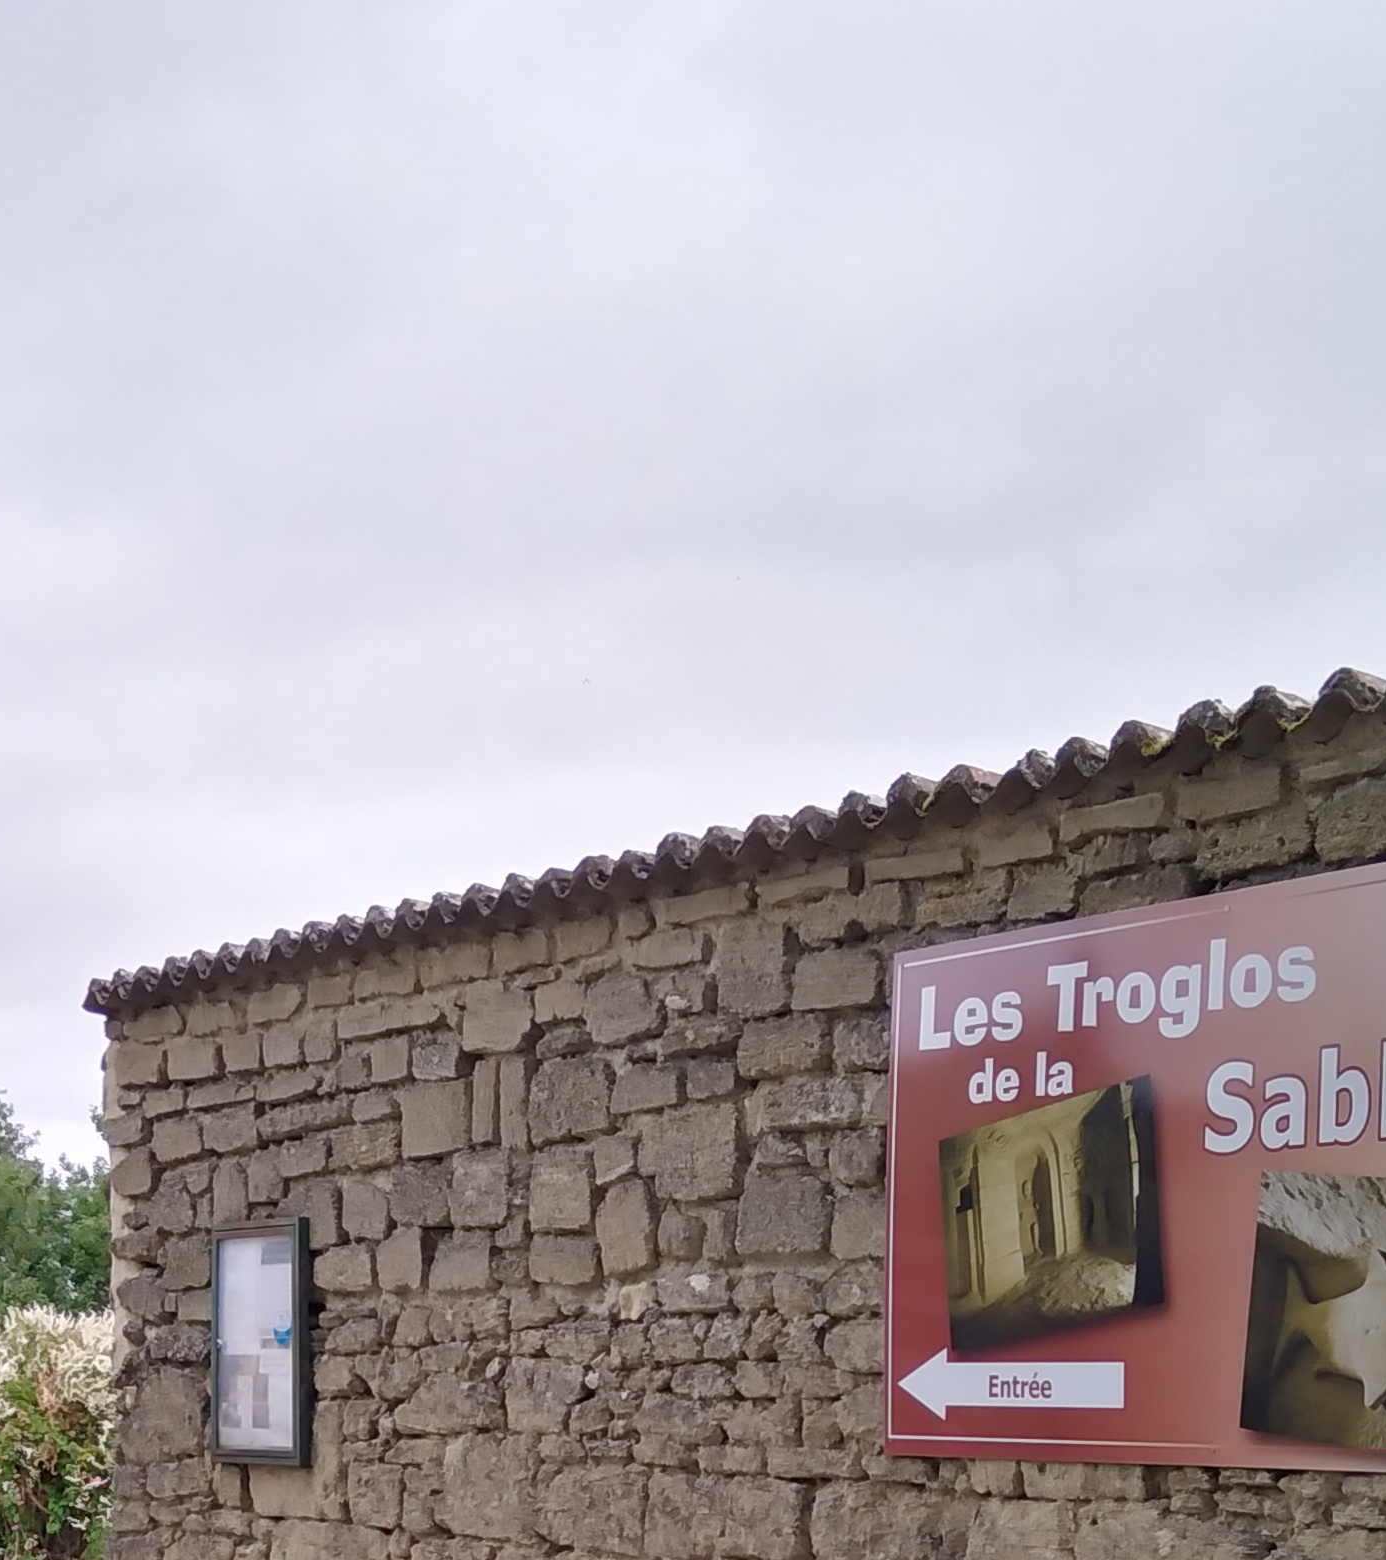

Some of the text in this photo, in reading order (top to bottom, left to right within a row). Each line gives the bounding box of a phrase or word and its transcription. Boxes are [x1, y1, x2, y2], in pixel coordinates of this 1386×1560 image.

[919, 937, 1317, 1051] Les Troglos
[968, 1051, 1074, 1105] de la
[988, 1371, 1053, 1399] Entrée
